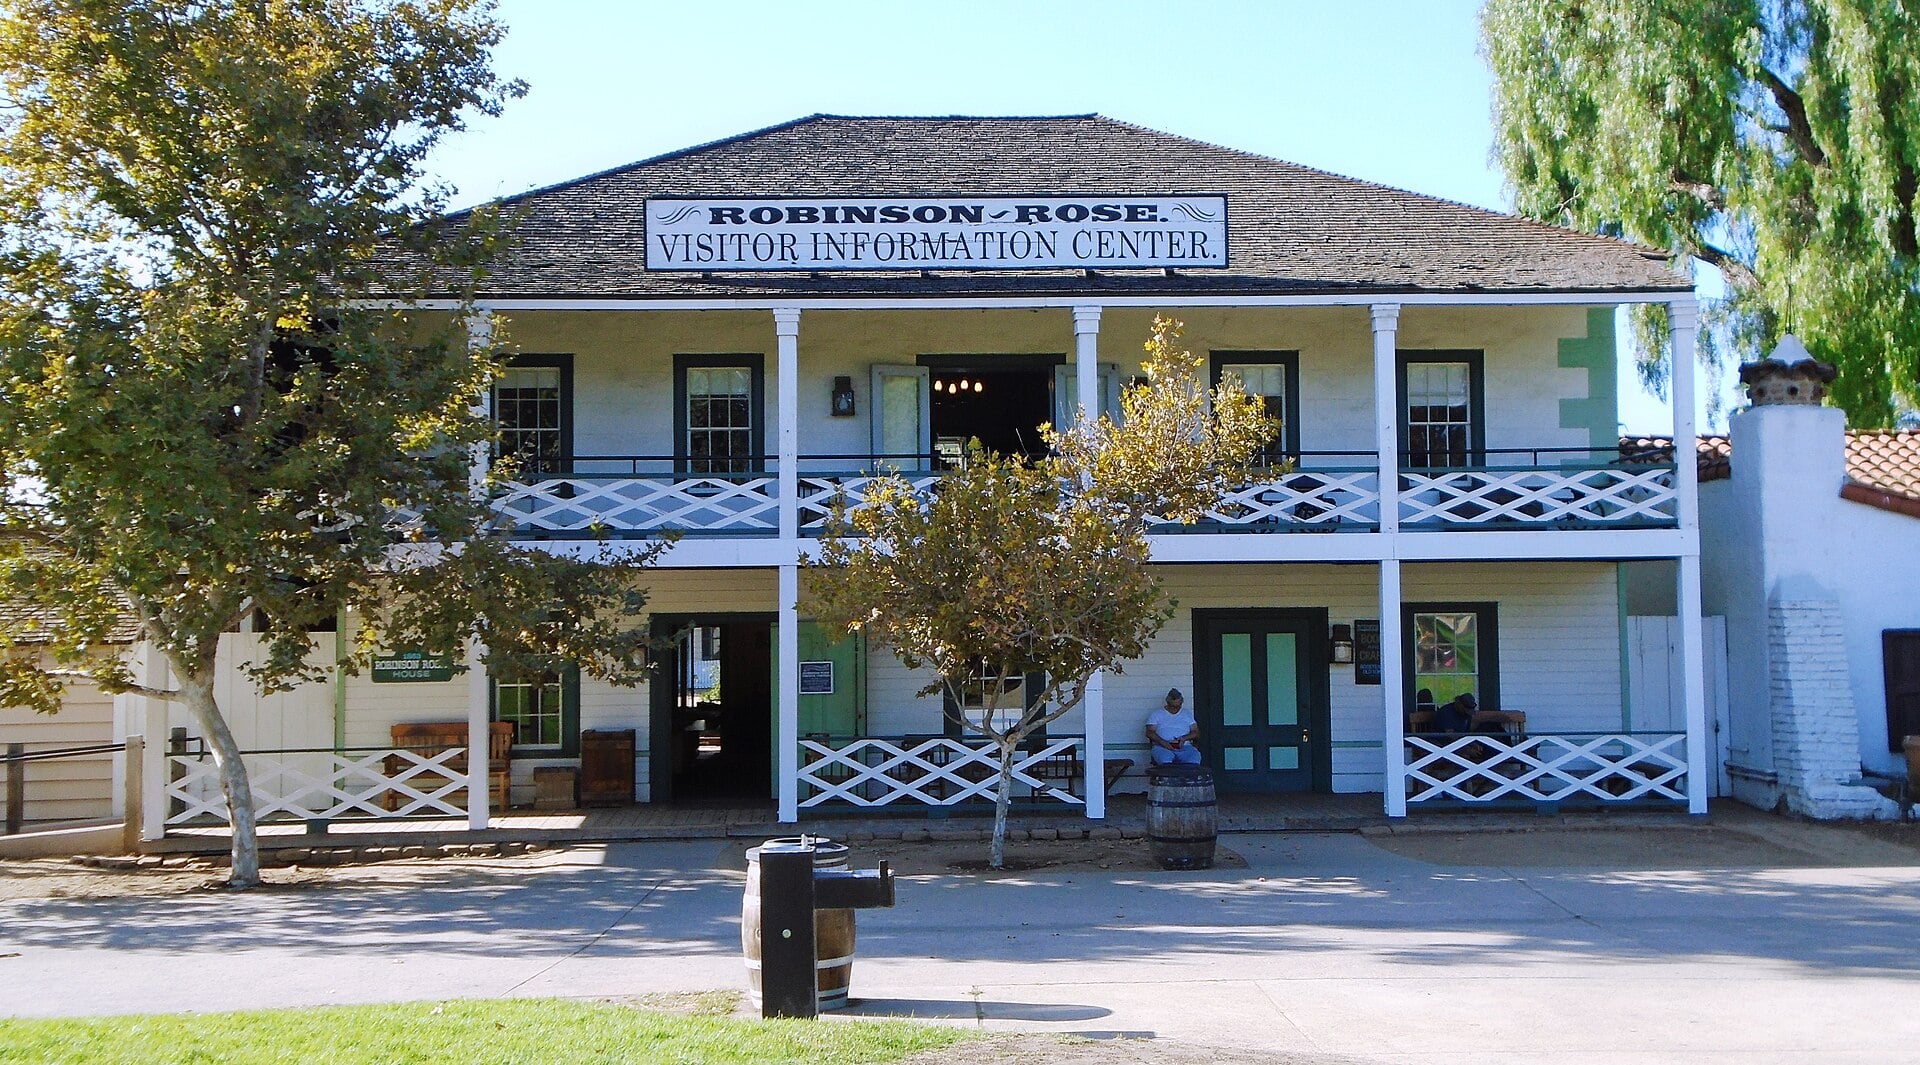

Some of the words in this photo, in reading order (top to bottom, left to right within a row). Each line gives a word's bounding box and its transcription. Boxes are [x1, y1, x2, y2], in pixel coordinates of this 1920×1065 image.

[656, 232, 800, 263] VISITOR
[809, 231, 1058, 262] INFORMATION
[1071, 230, 1218, 260] CENTER.
[375, 660, 420, 670] ROBINSON
[422, 660, 448, 670] ROS
[393, 670, 430, 678] HOUSE
